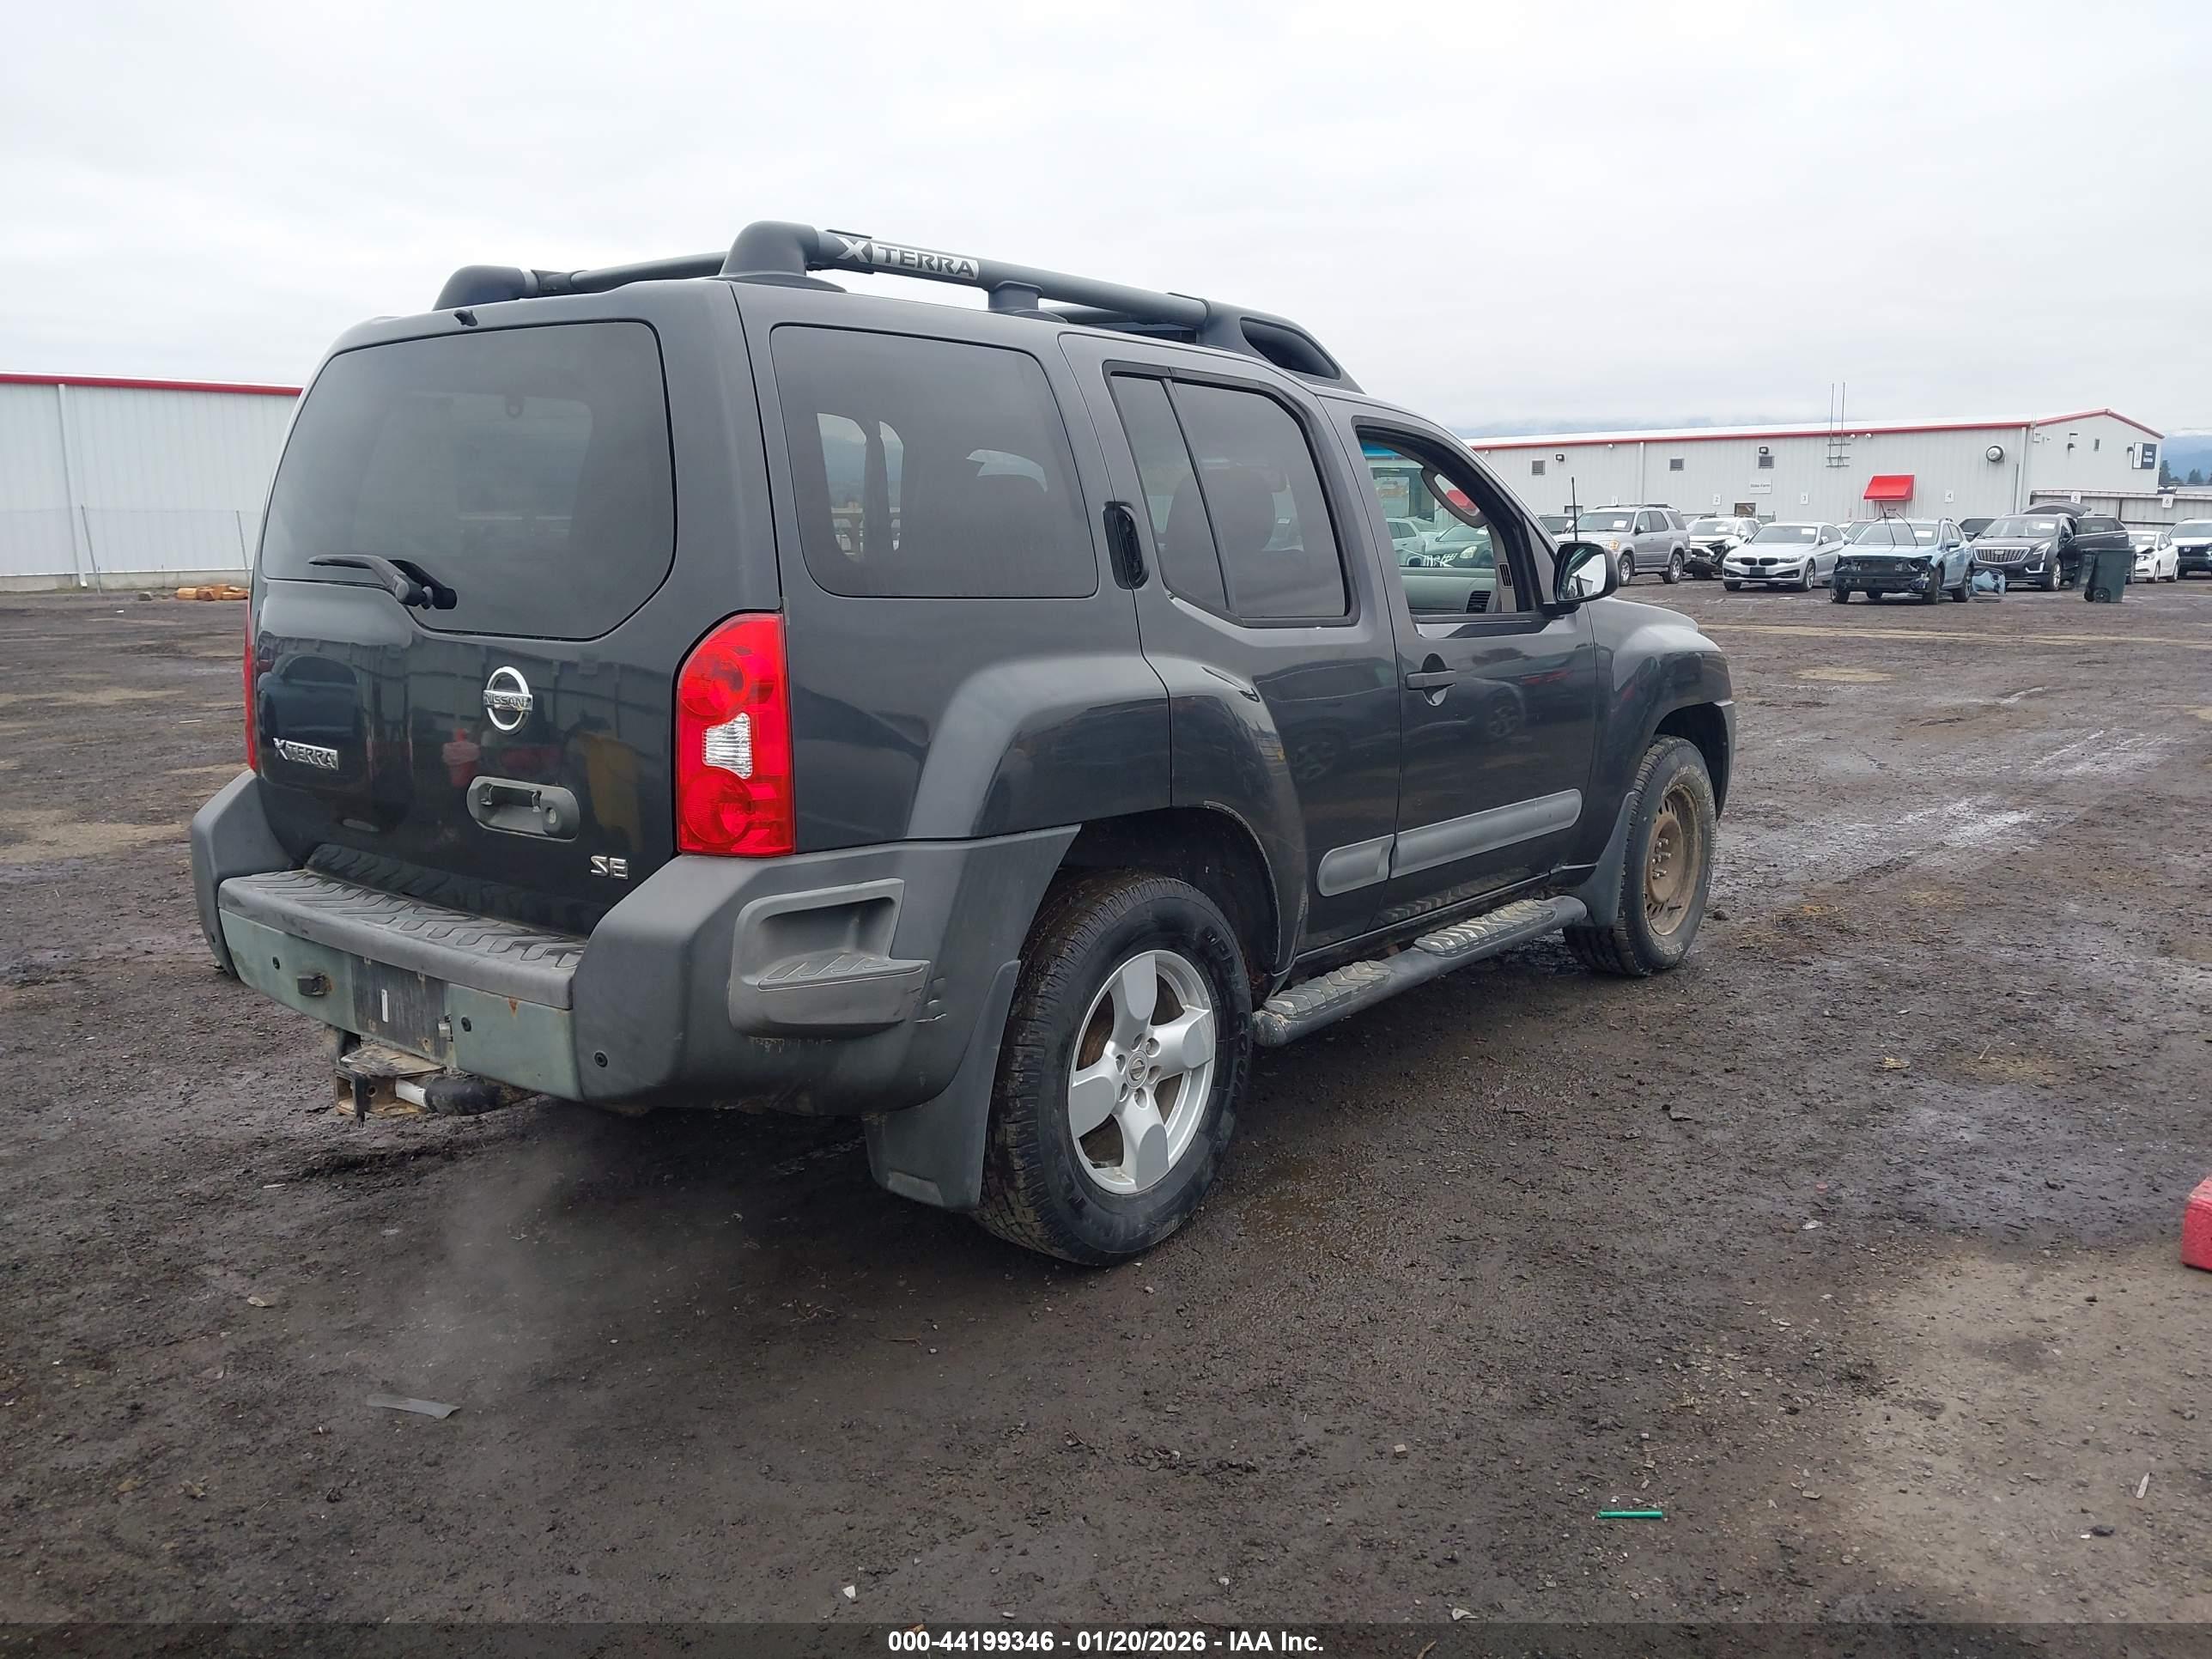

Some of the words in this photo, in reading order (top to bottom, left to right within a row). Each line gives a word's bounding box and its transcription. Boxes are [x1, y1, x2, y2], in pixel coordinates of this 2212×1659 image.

[835, 236, 975, 278] XTERRA
[483, 691, 527, 709] NISSAN
[273, 737, 339, 770] XTERRA
[591, 855, 629, 879] SE
